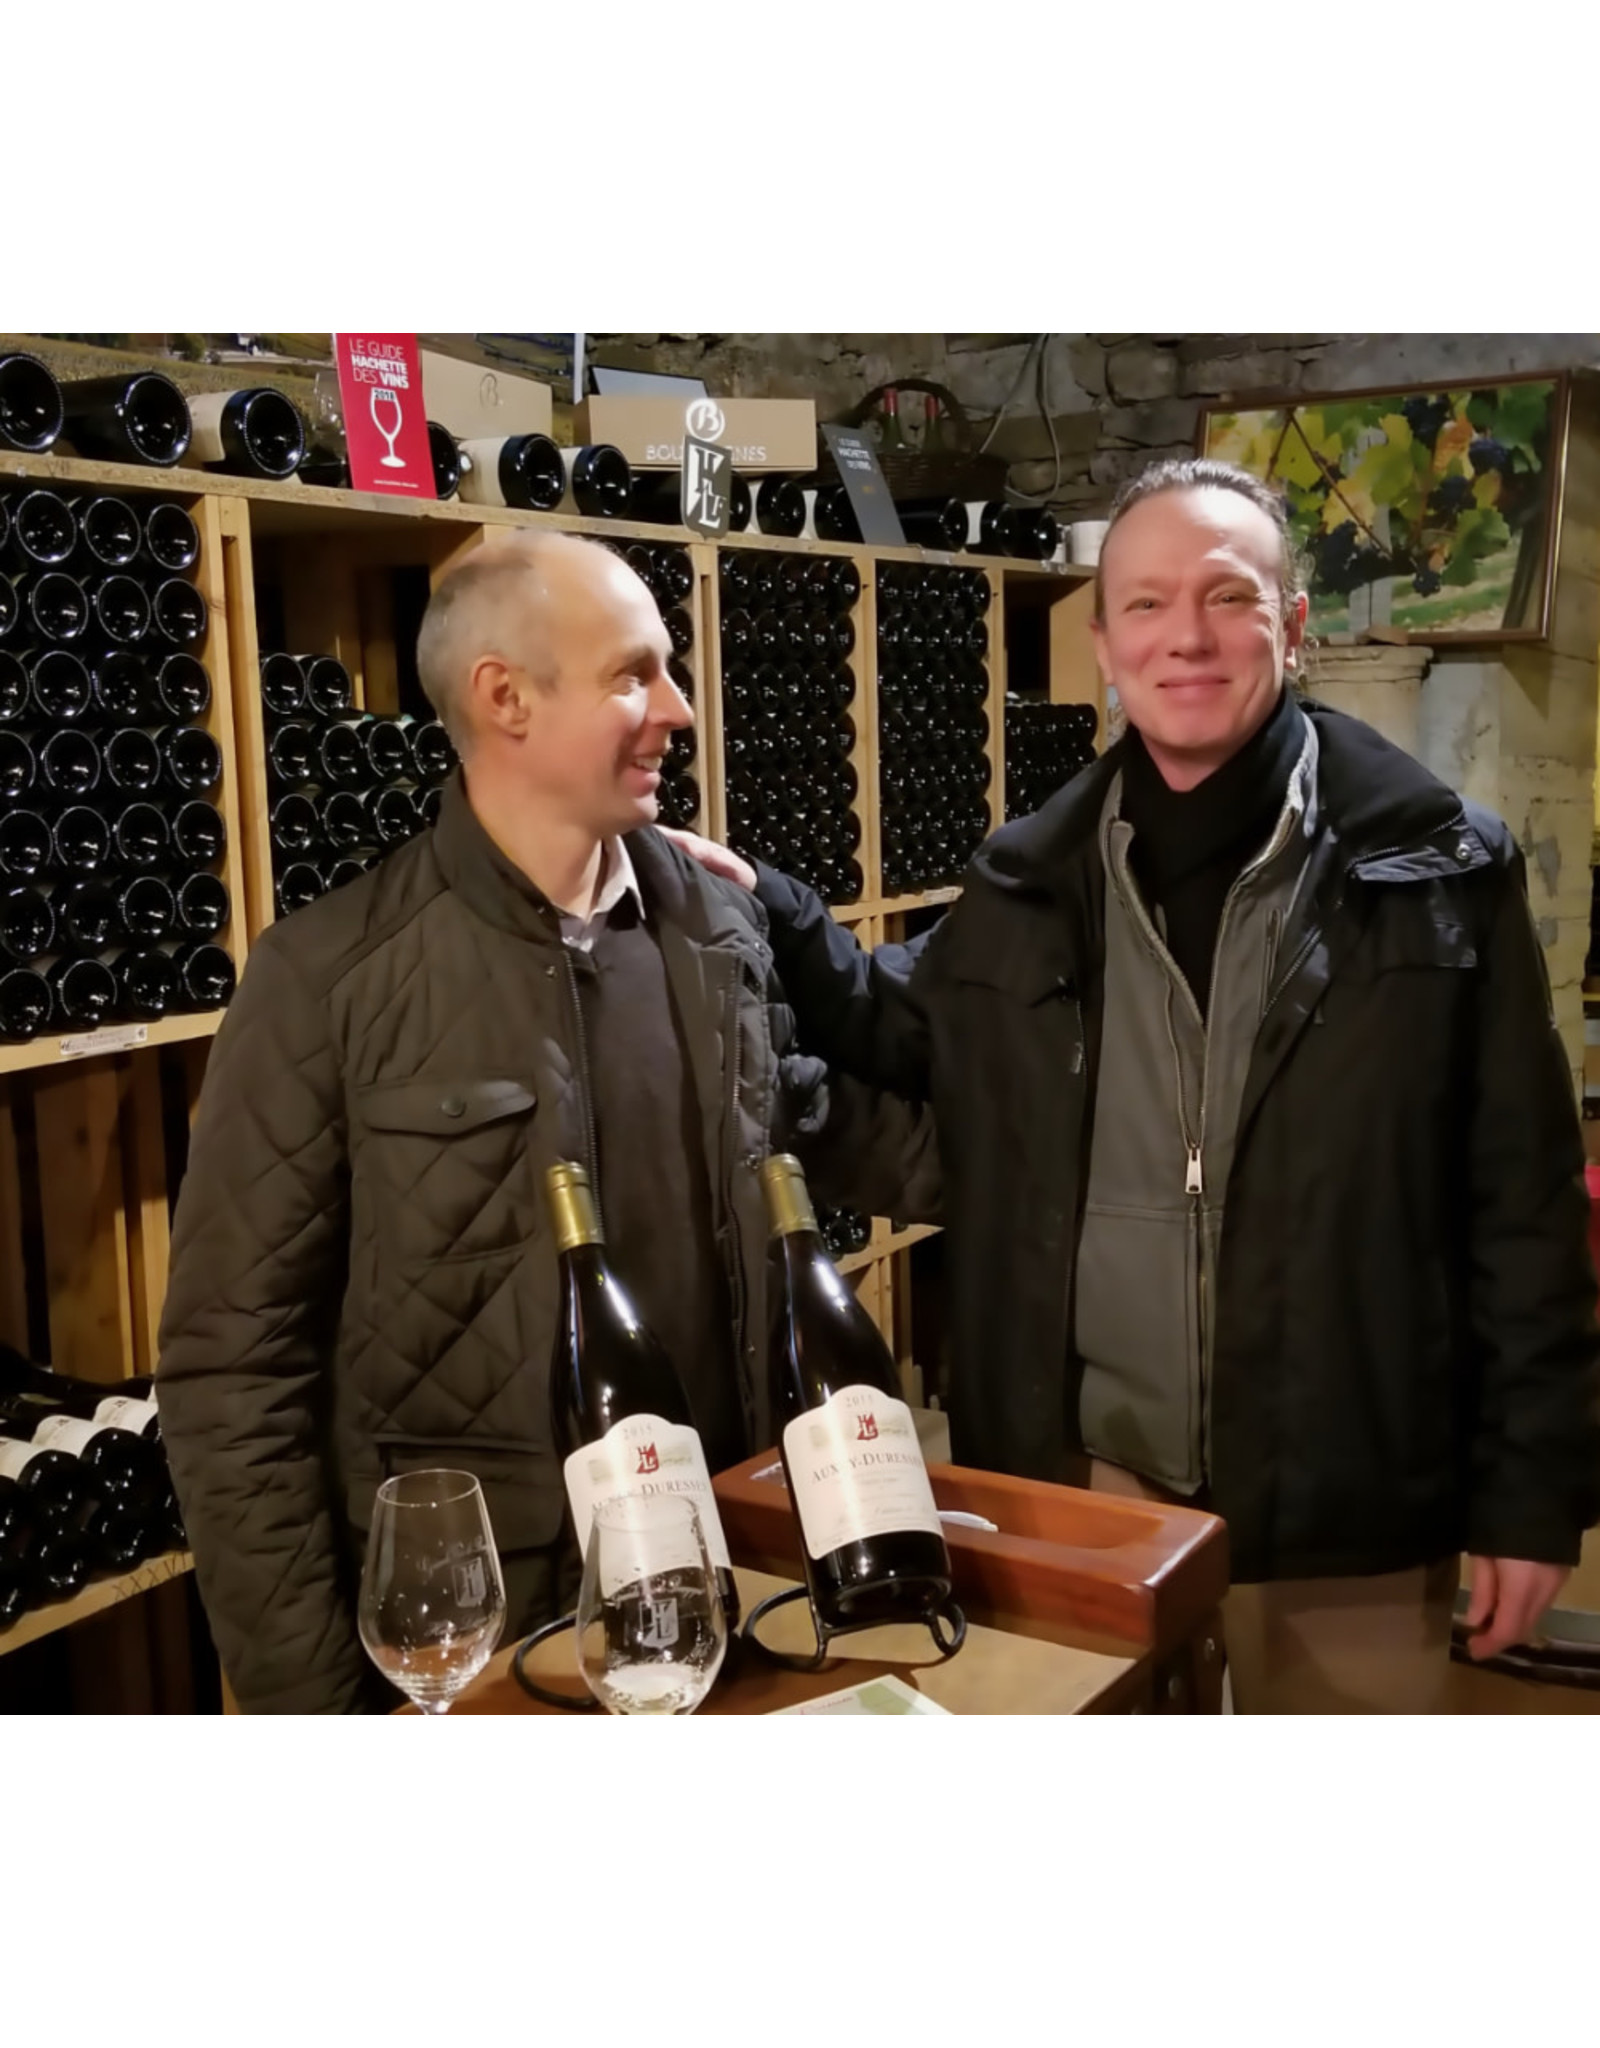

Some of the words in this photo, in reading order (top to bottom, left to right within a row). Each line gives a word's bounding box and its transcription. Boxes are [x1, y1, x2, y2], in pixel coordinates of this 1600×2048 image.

[349, 338, 365, 354] LE
[367, 341, 404, 361] GUIDE
[351, 353, 407, 375] HACHETTE
[353, 367, 378, 385] DES
[379, 371, 409, 390] VINS
